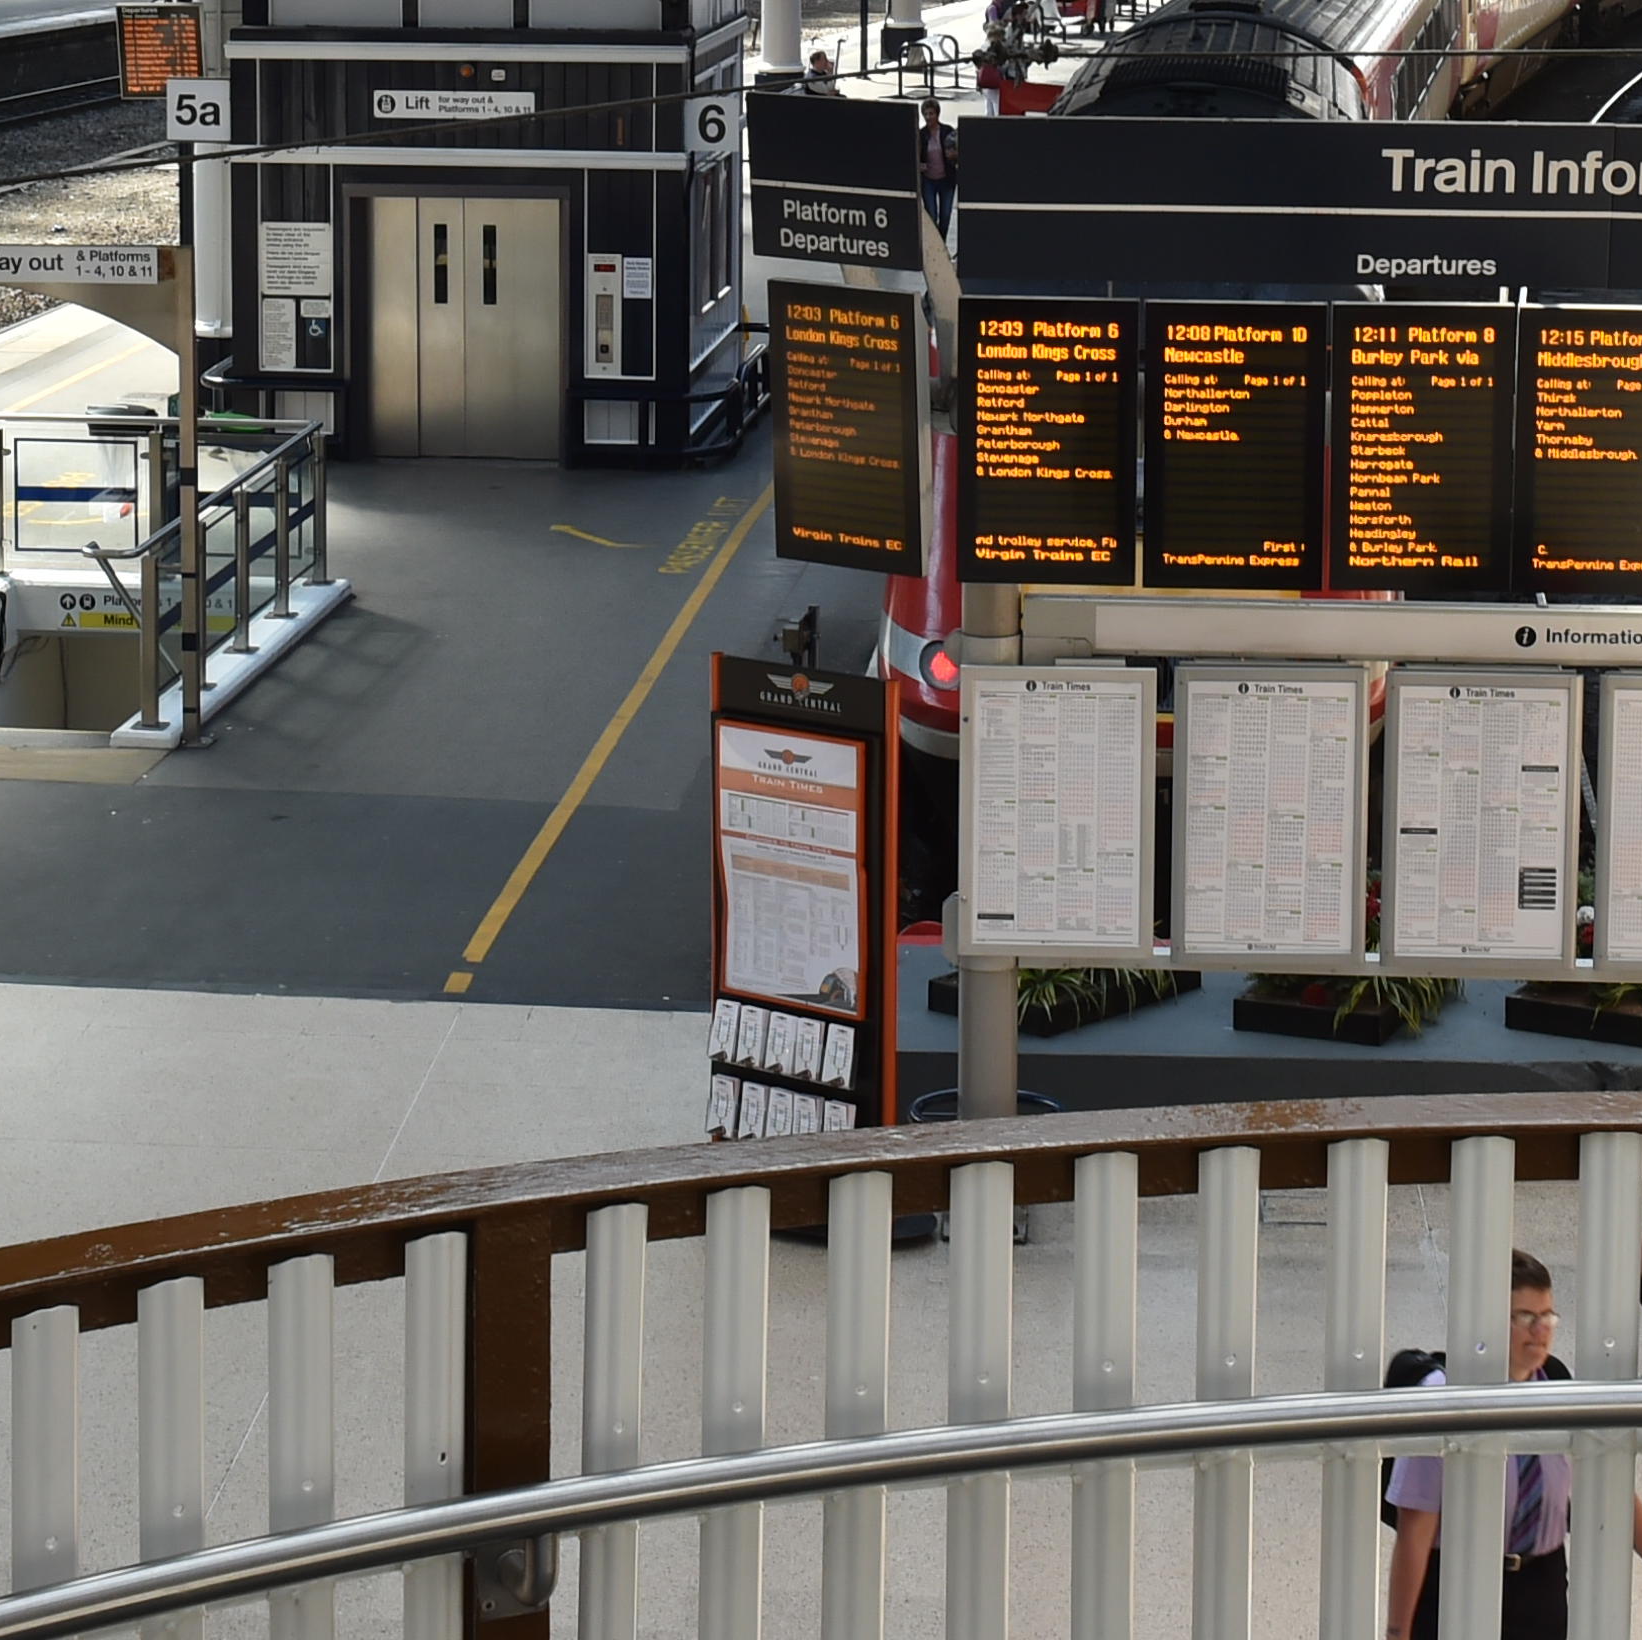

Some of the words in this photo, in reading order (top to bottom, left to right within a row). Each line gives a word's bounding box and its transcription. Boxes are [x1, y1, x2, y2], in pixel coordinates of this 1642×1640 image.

[405, 96, 430, 110] Lift
[174, 94, 221, 126] 5a
[697, 104, 726, 144] 6
[1381, 148, 1516, 193] Train
[783, 199, 866, 227] Platform
[875, 208, 888, 228] 6
[780, 228, 889, 258] Departures
[28, 254, 63, 271] out
[76, 250, 85, 261] &
[90, 250, 151, 262] Platforms
[76, 266, 81, 276] 1
[111, 266, 124, 276] 10
[128, 266, 137, 276] &
[140, 267, 152, 277] 11
[1356, 254, 1497, 278] Departures
[830, 308, 885, 328] Platform
[890, 315, 899, 330] 6
[980, 320, 1023, 337] 12:03
[1033, 321, 1101, 338] Platform
[1108, 323, 1119, 339] 6
[1167, 325, 1211, 341] 12:08
[1214, 326, 1283, 342] Platform
[1292, 327, 1307, 342] 10
[1354, 326, 1396, 342] 12:11
[1408, 327, 1477, 343] Platform
[1484, 327, 1495, 343] 8
[786, 325, 825, 343] London
[830, 330, 859, 348] Kings
[864, 334, 897, 351] Cross
[1541, 329, 1584, 345] 12:15
[977, 342, 1027, 358] London
[1032, 343, 1069, 361] Kings
[1074, 345, 1116, 360] Cross
[1164, 347, 1245, 364] Newcastle
[1351, 349, 1403, 366] Burley
[1410, 349, 1449, 365] Park
[1457, 349, 1479, 365] via
[977, 383, 1039, 395] Doncaster
[1164, 388, 1250, 399] Northallerton
[977, 397, 1025, 408] Retford
[1164, 402, 1230, 414] Darlington
[1536, 406, 1622, 418] Northallerton
[1351, 431, 1443, 443] Knaresborough
[1536, 434, 1593, 446] Thornaby
[976, 439, 1060, 451] Peterborough
[1350, 459, 1414, 470] Harrogate
[1350, 487, 1390, 497] Pannal
[792, 526, 833, 541] Virgin
[839, 533, 880, 548] Trains
[886, 539, 902, 550] EC
[1349, 528, 1416, 540] Headingley
[975, 548, 1025, 560] Virgin
[1033, 549, 1084, 561] Trains
[1091, 550, 1110, 561] EC
[1349, 556, 1434, 567] Northern
[1441, 556, 1479, 567] Rail
[103, 614, 134, 626] Mind
[1043, 681, 1063, 691] Train
[1066, 681, 1091, 691] Times
[1255, 684, 1276, 694] Train
[1279, 684, 1304, 695] Times
[760, 691, 793, 705] GRAND
[1466, 688, 1487, 697] Train
[1490, 688, 1516, 698] Times
